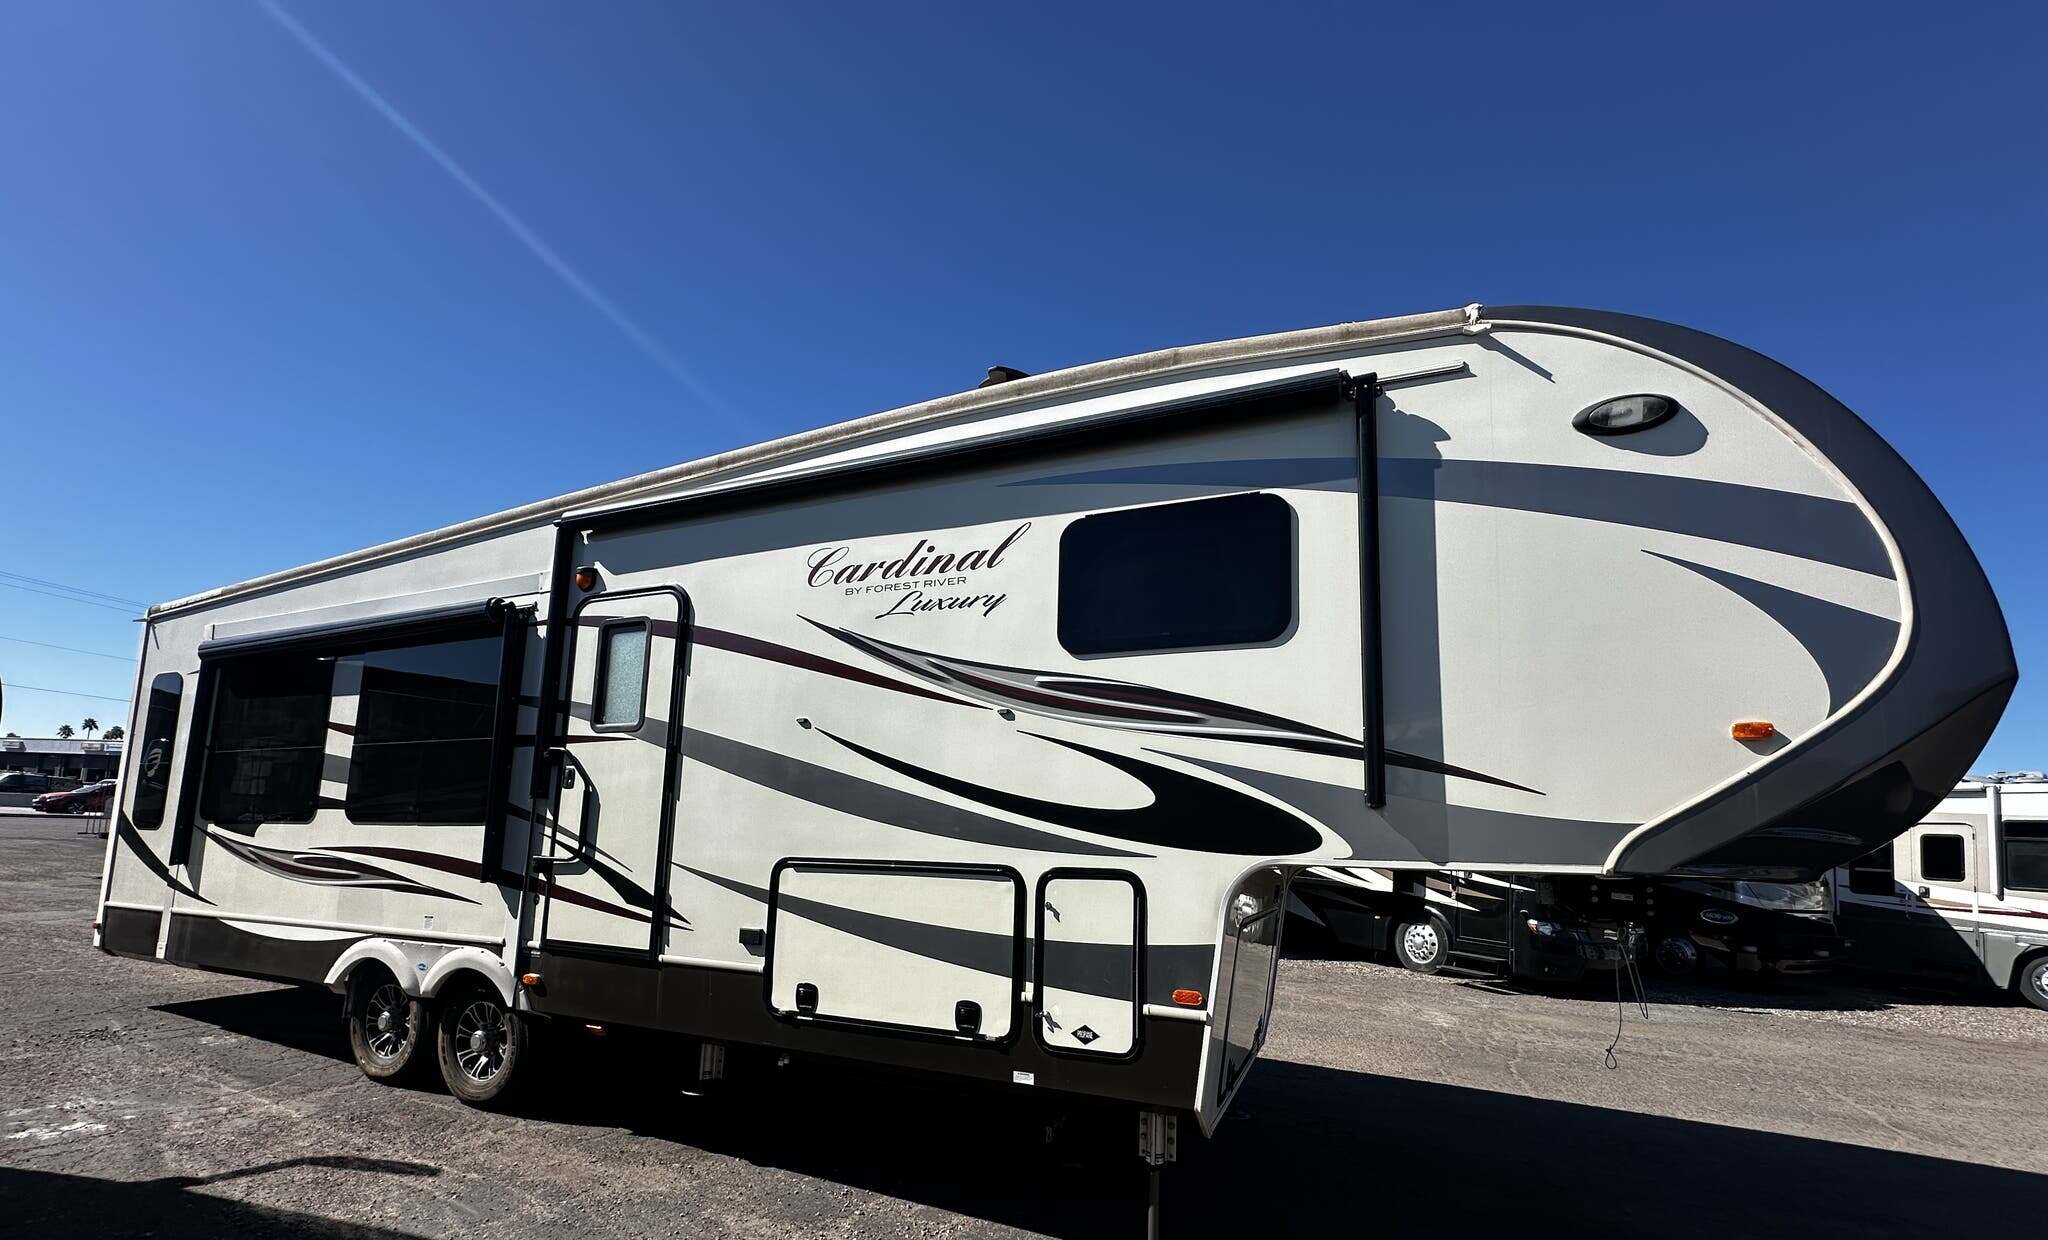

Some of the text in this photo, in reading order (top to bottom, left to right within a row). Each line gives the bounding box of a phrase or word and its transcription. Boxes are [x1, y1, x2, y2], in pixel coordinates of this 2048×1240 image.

[807, 521, 1032, 588] Cardinal
[844, 576, 967, 596] BY FOREST RIVER
[874, 590, 1008, 620] Luxury
